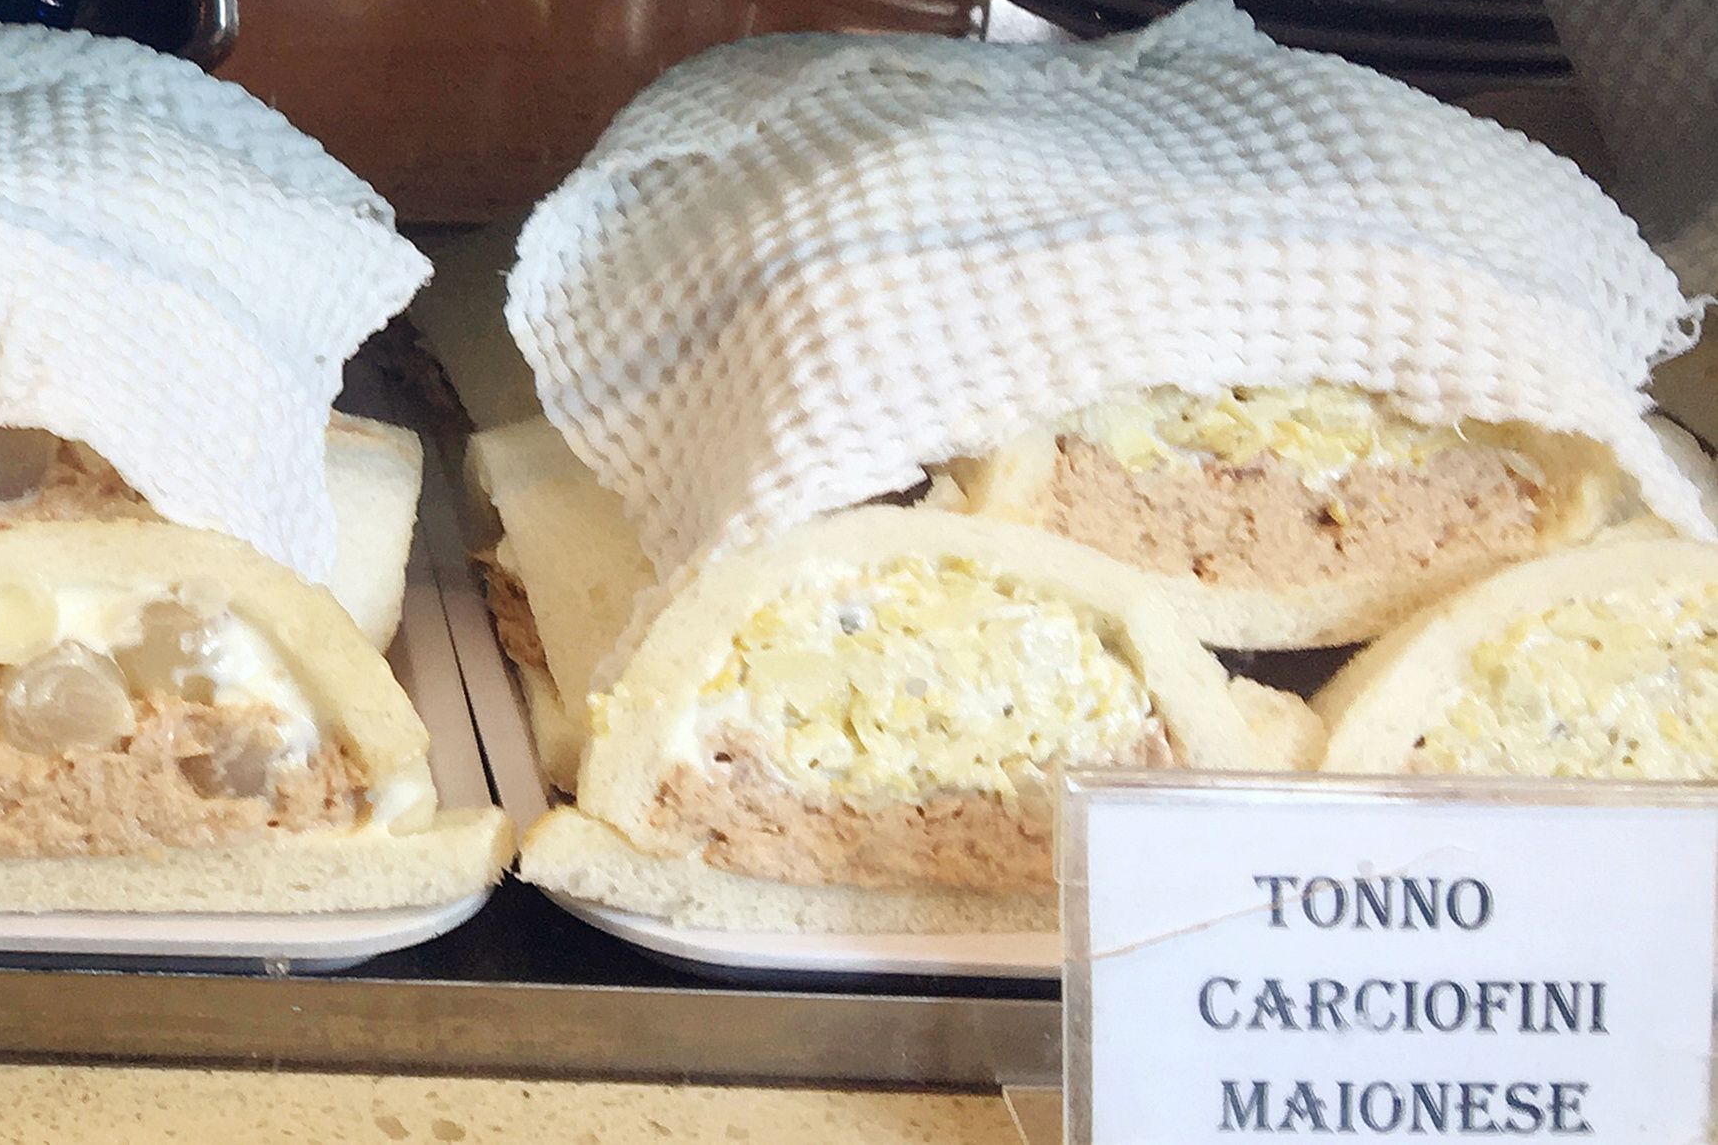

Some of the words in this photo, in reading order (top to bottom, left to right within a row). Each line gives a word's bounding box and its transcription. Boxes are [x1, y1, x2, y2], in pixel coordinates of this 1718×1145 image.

[1253, 875, 1494, 931] TONNO
[1198, 976, 1610, 1035] CARCIOFINI
[1218, 1080, 1594, 1135] MAIONESE
